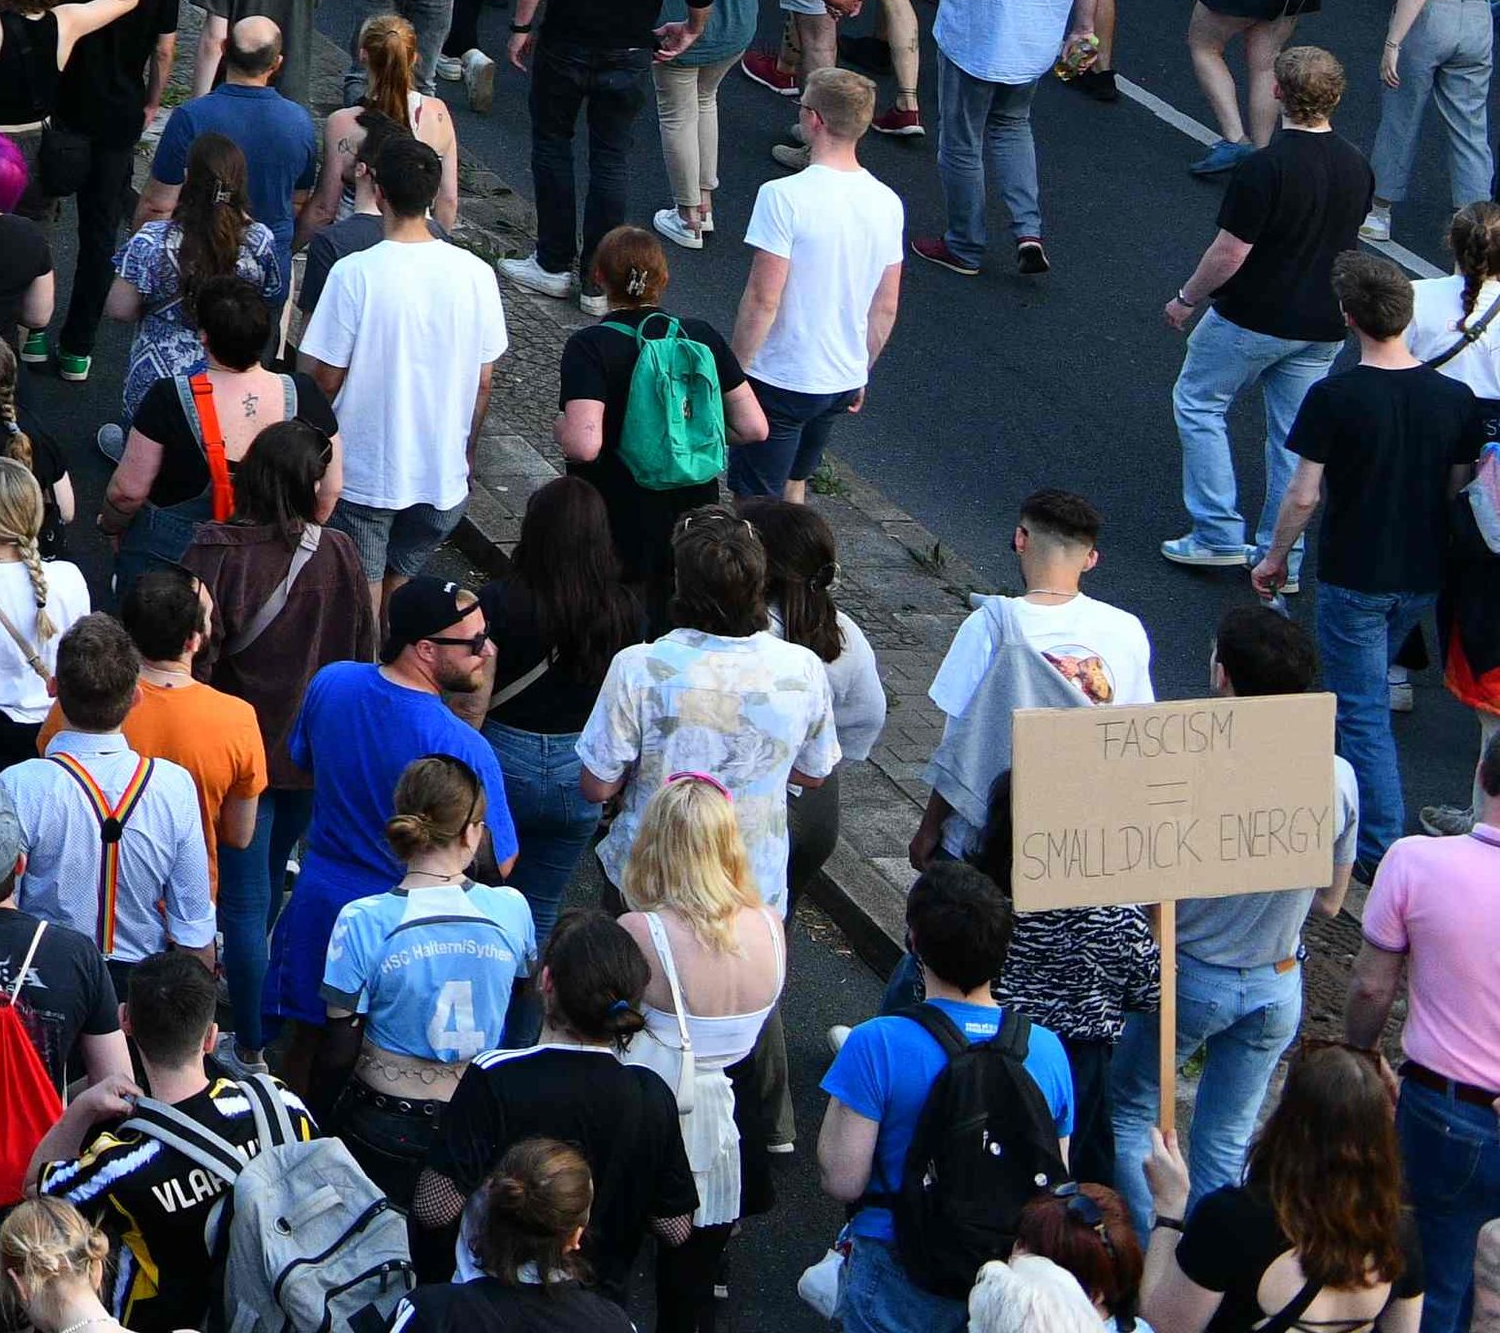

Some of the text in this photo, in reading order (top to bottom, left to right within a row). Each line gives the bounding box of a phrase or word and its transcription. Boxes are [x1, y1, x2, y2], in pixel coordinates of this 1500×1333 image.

[1096, 711, 1235, 760] FASCISM
[1220, 805, 1333, 863] ENERGY
[381, 950, 411, 974] HSC
[426, 980, 486, 1063] 4
